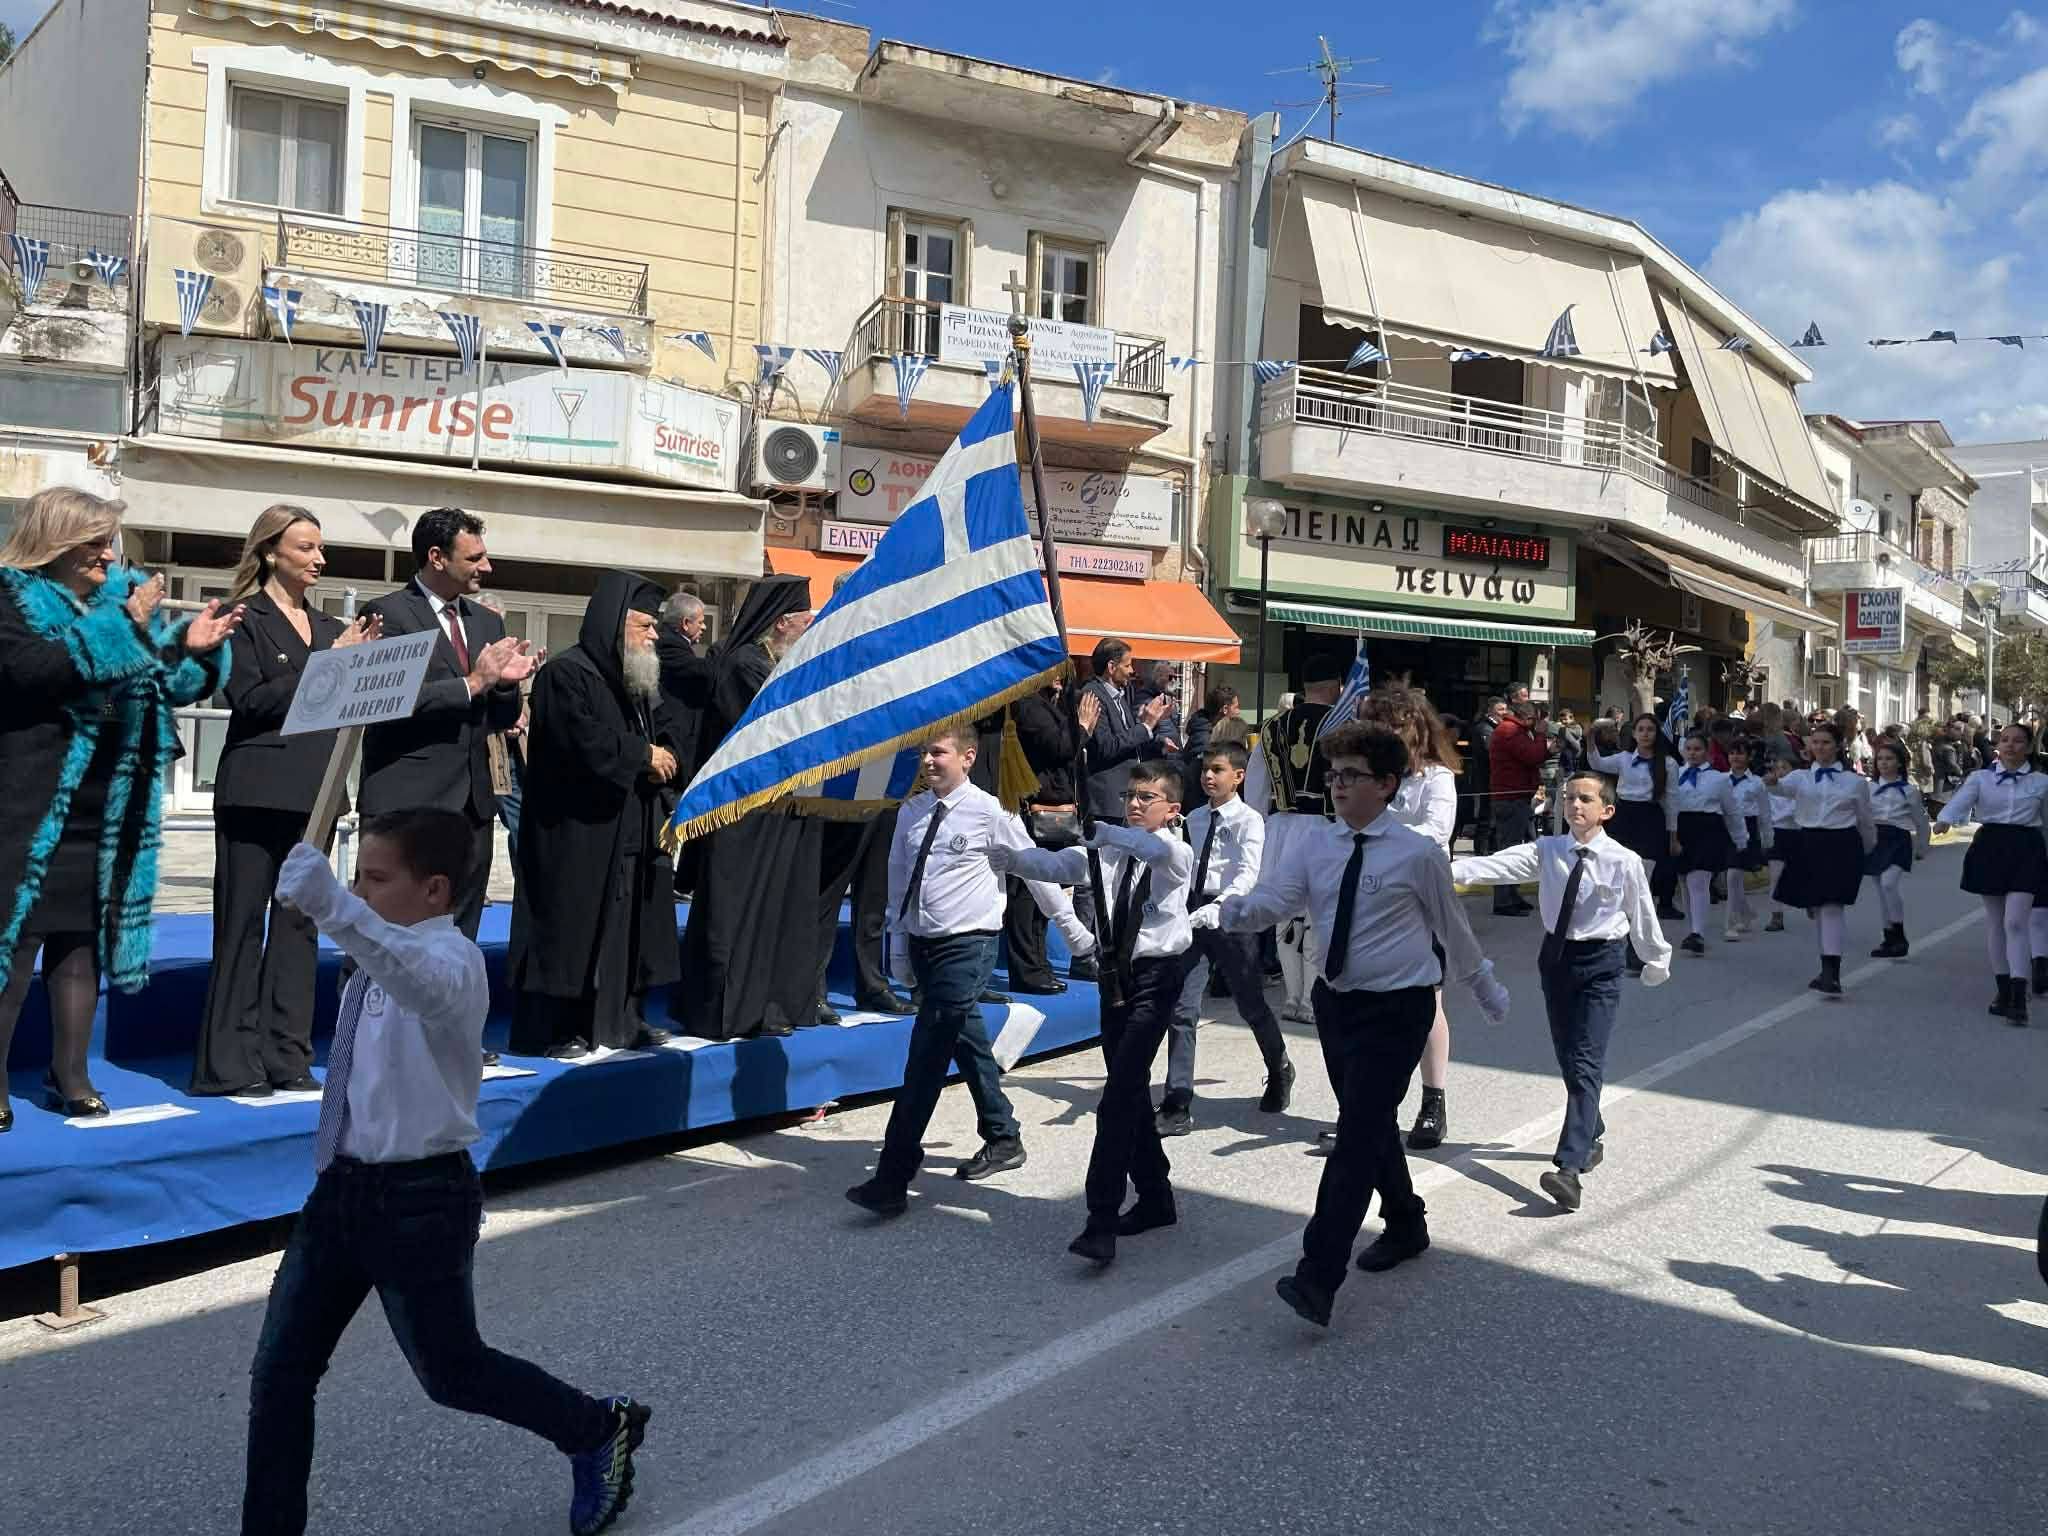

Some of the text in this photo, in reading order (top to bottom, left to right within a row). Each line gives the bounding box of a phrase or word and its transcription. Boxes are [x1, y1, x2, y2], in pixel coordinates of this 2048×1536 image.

[283, 375, 513, 440] Sunrise
[655, 424, 721, 460] Sunrise
[828, 527, 881, 549] ΕΛΕΝΗ
[1092, 558, 1145, 574] 2223023612
[1394, 564, 1536, 605] πεινάω
[1860, 590, 1900, 607] ΣΧΟΛΗ
[1859, 609, 1900, 626] ΟΔΗΓΩΝ
[366, 641, 429, 667] ΔΗΜΟΤΙΚΟ
[352, 669, 406, 693] ΣΧΟΛΕΙΟ
[338, 695, 404, 721] ΑΛΙΒΕΡΙΟΥ
